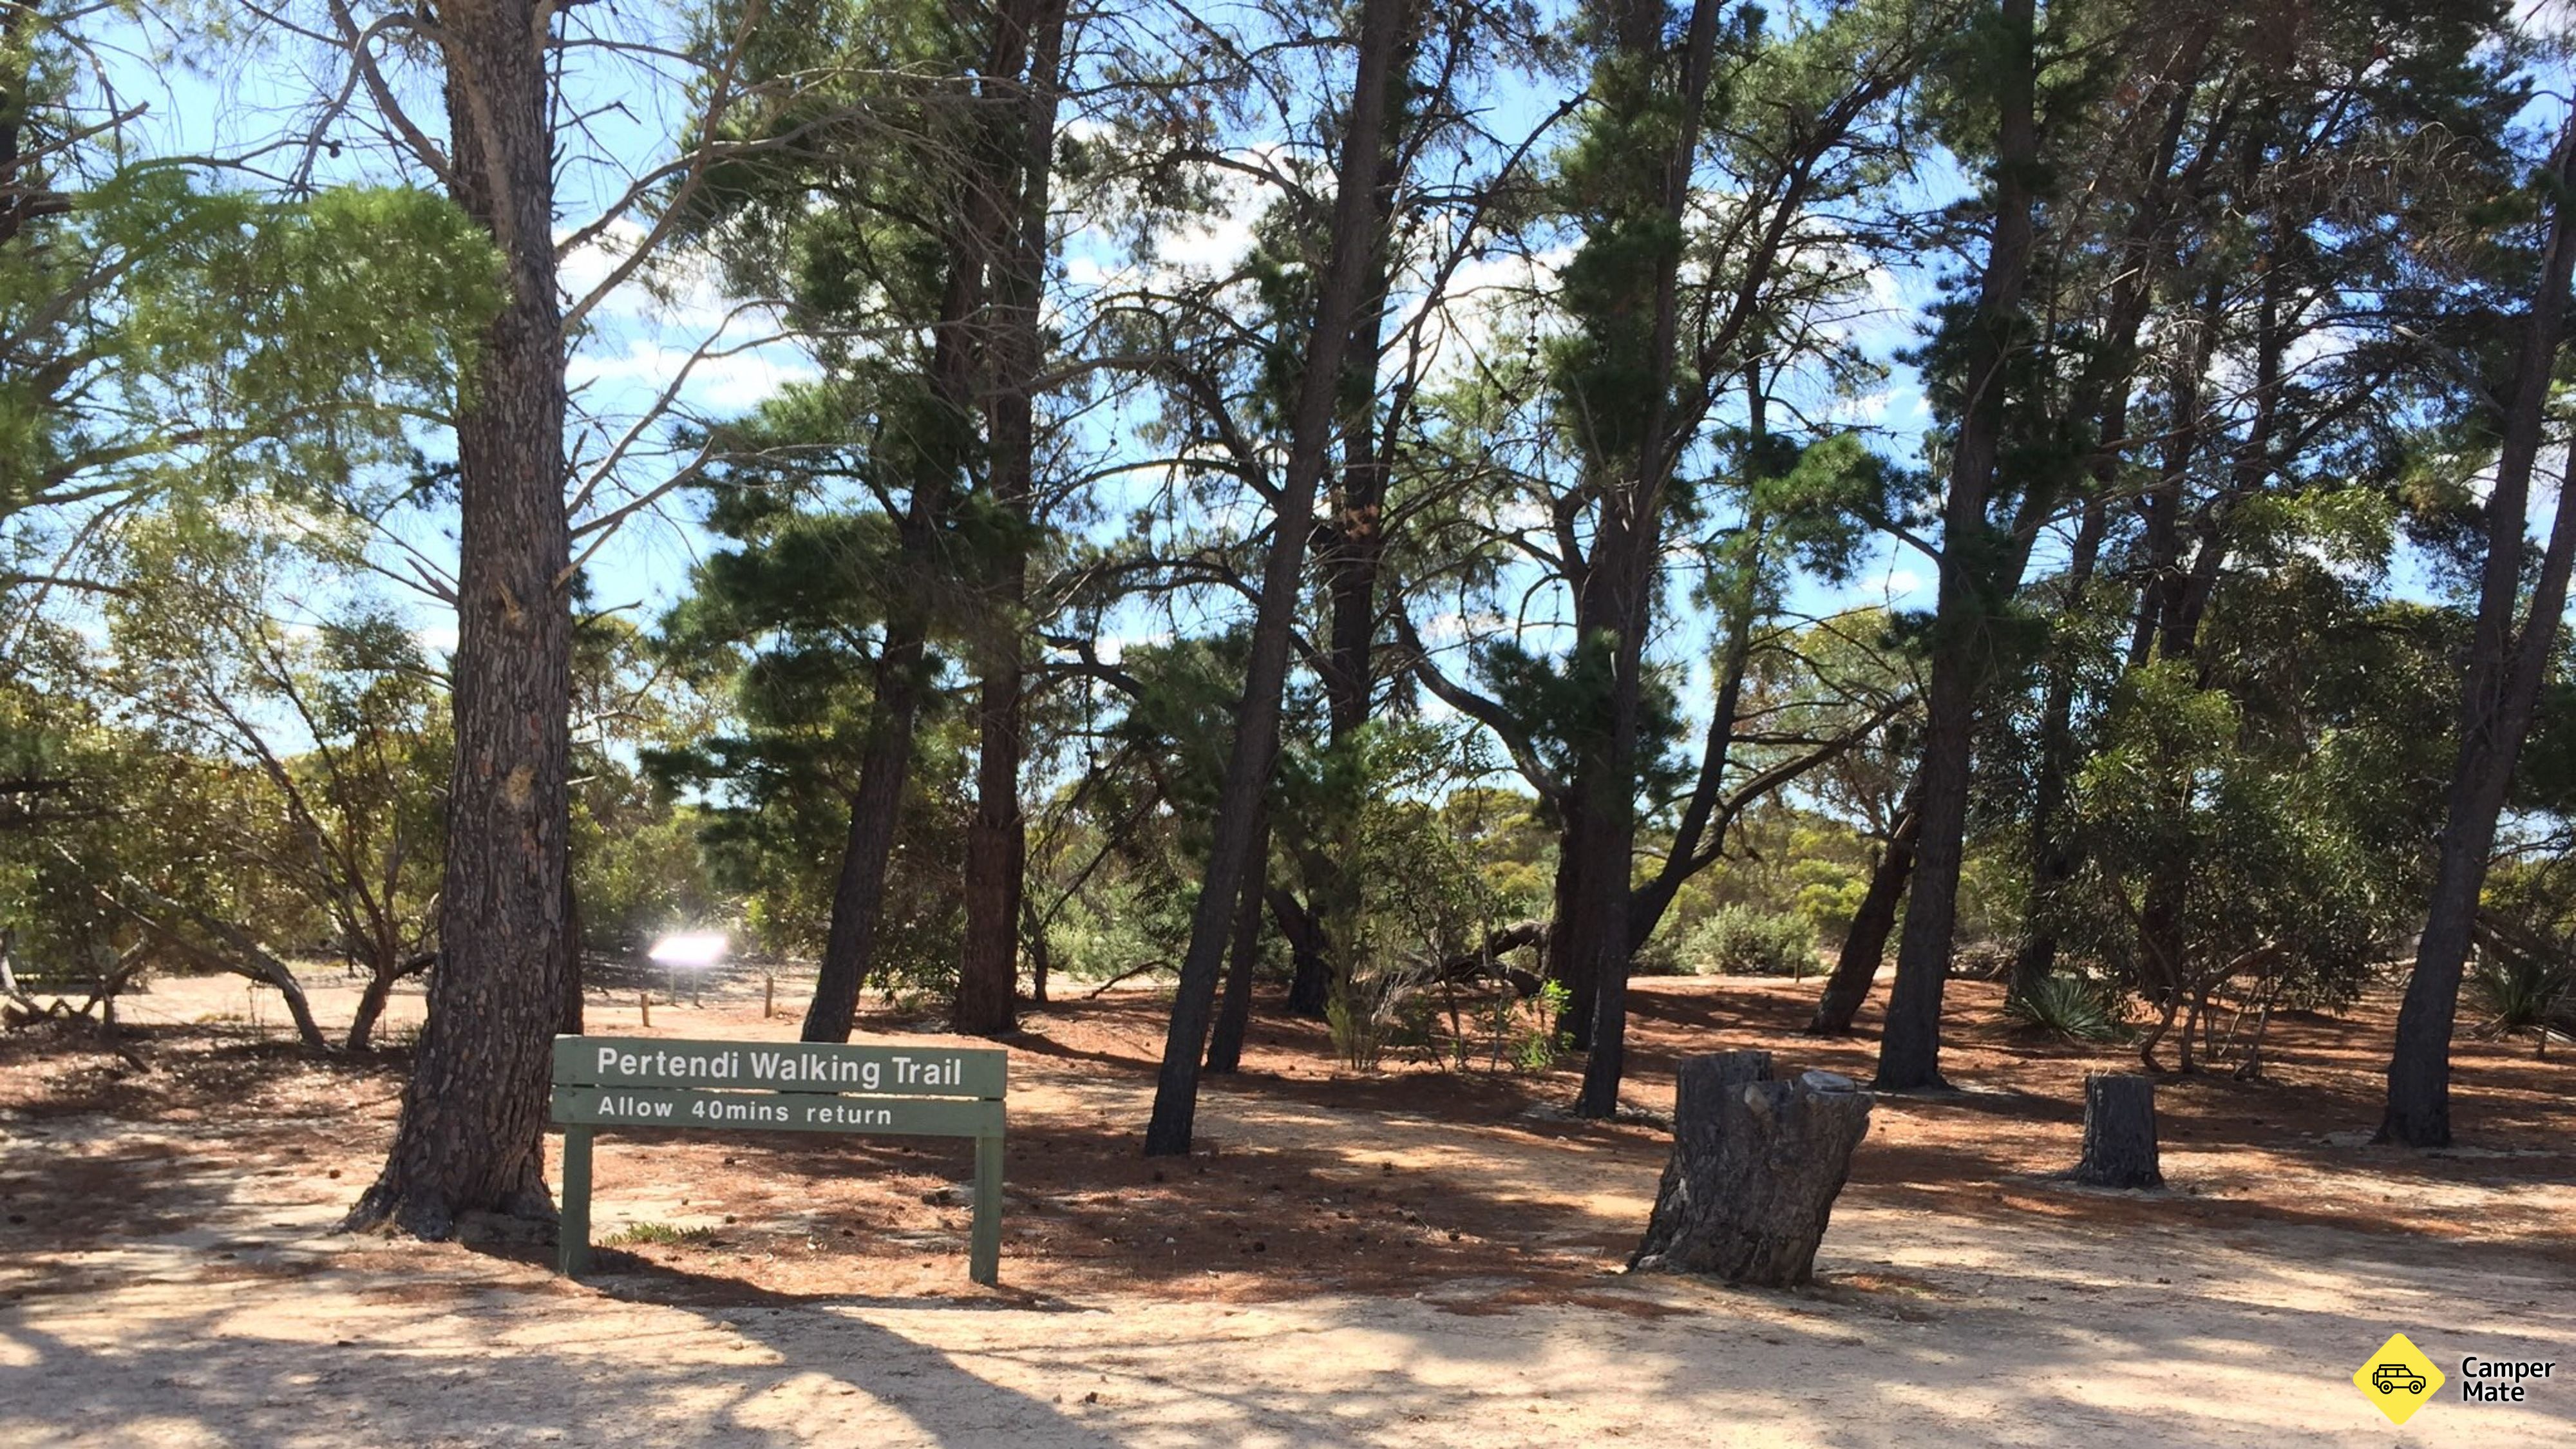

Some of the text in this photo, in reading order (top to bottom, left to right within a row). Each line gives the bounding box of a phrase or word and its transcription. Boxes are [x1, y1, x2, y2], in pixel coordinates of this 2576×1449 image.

[596, 1046, 962, 1090] Pertendi Walking Trail
[598, 1096, 892, 1125] Allow 40mins return
